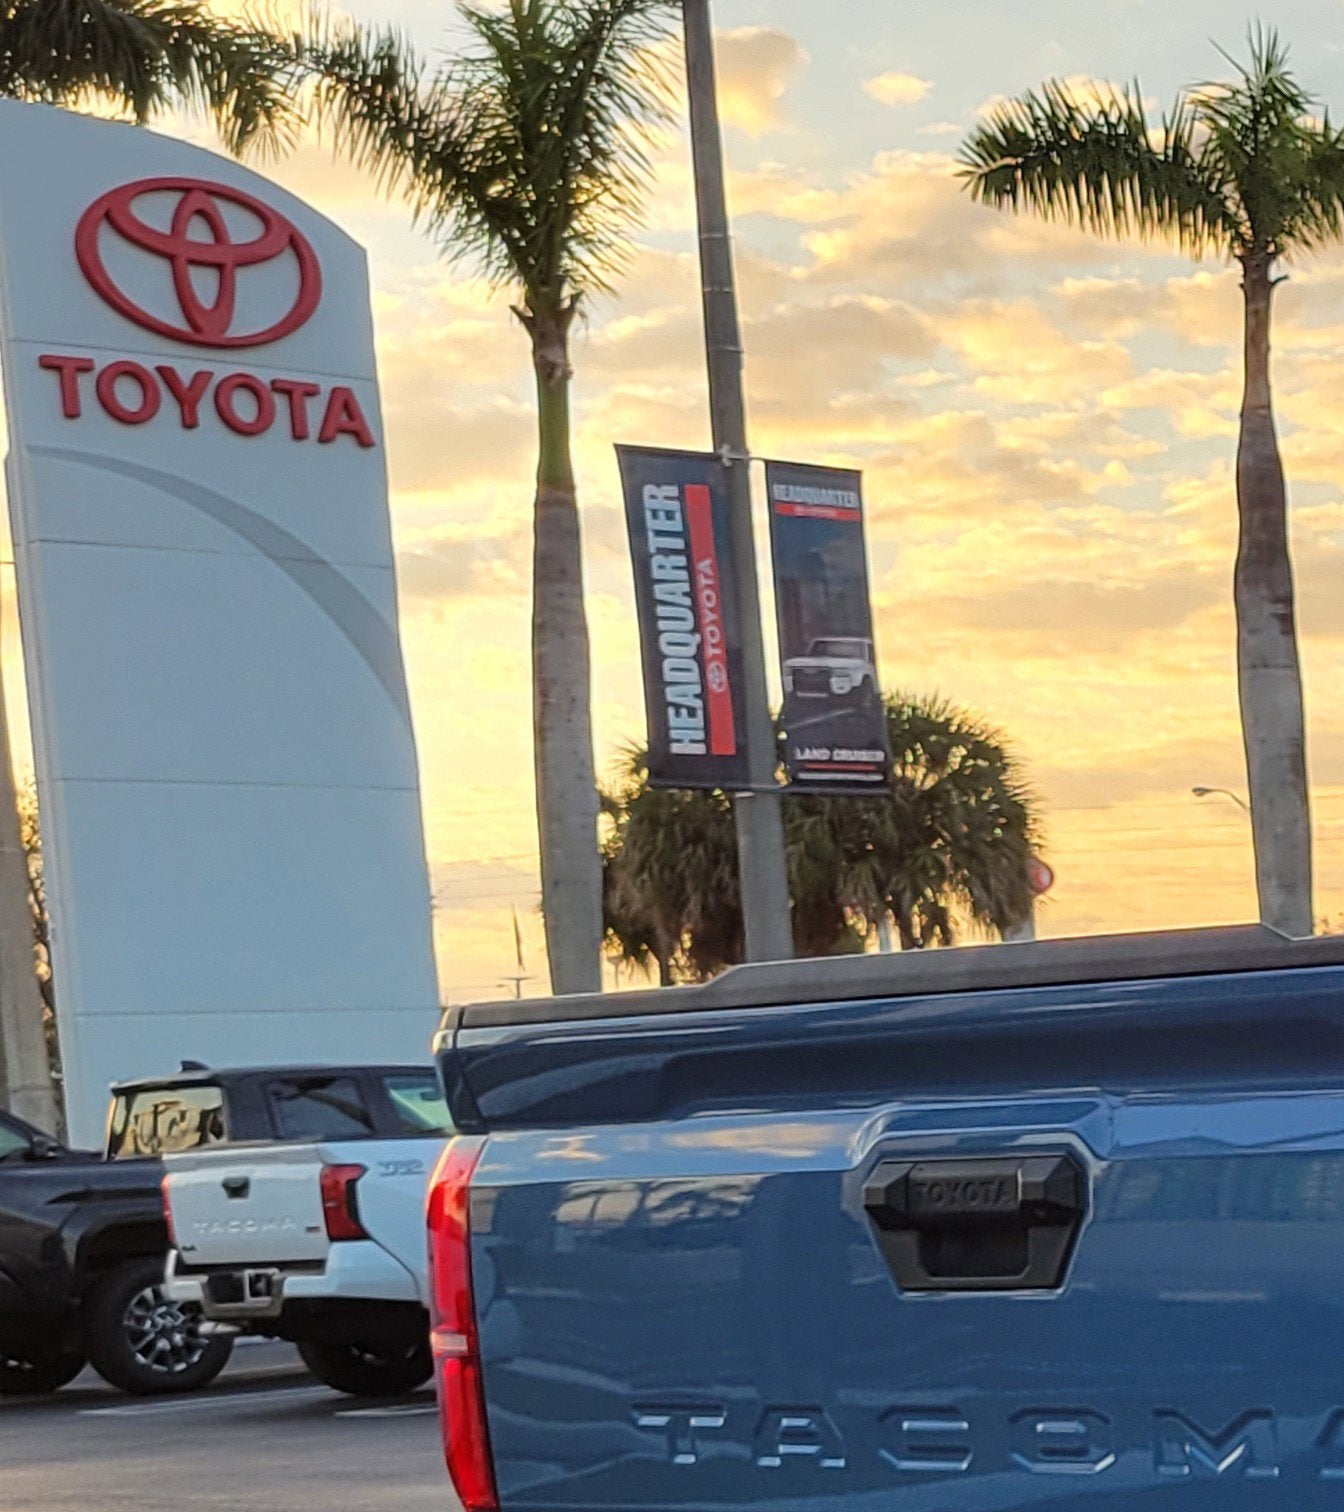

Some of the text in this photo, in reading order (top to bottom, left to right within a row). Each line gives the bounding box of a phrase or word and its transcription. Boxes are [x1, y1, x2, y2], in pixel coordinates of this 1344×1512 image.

[38, 354, 375, 447] TOYOTA
[643, 483, 707, 755] HEADQUARTER
[696, 558, 723, 657] TOYOTA
[193, 1215, 297, 1234] TACOMA
[915, 1179, 1014, 1207] TOYOTA
